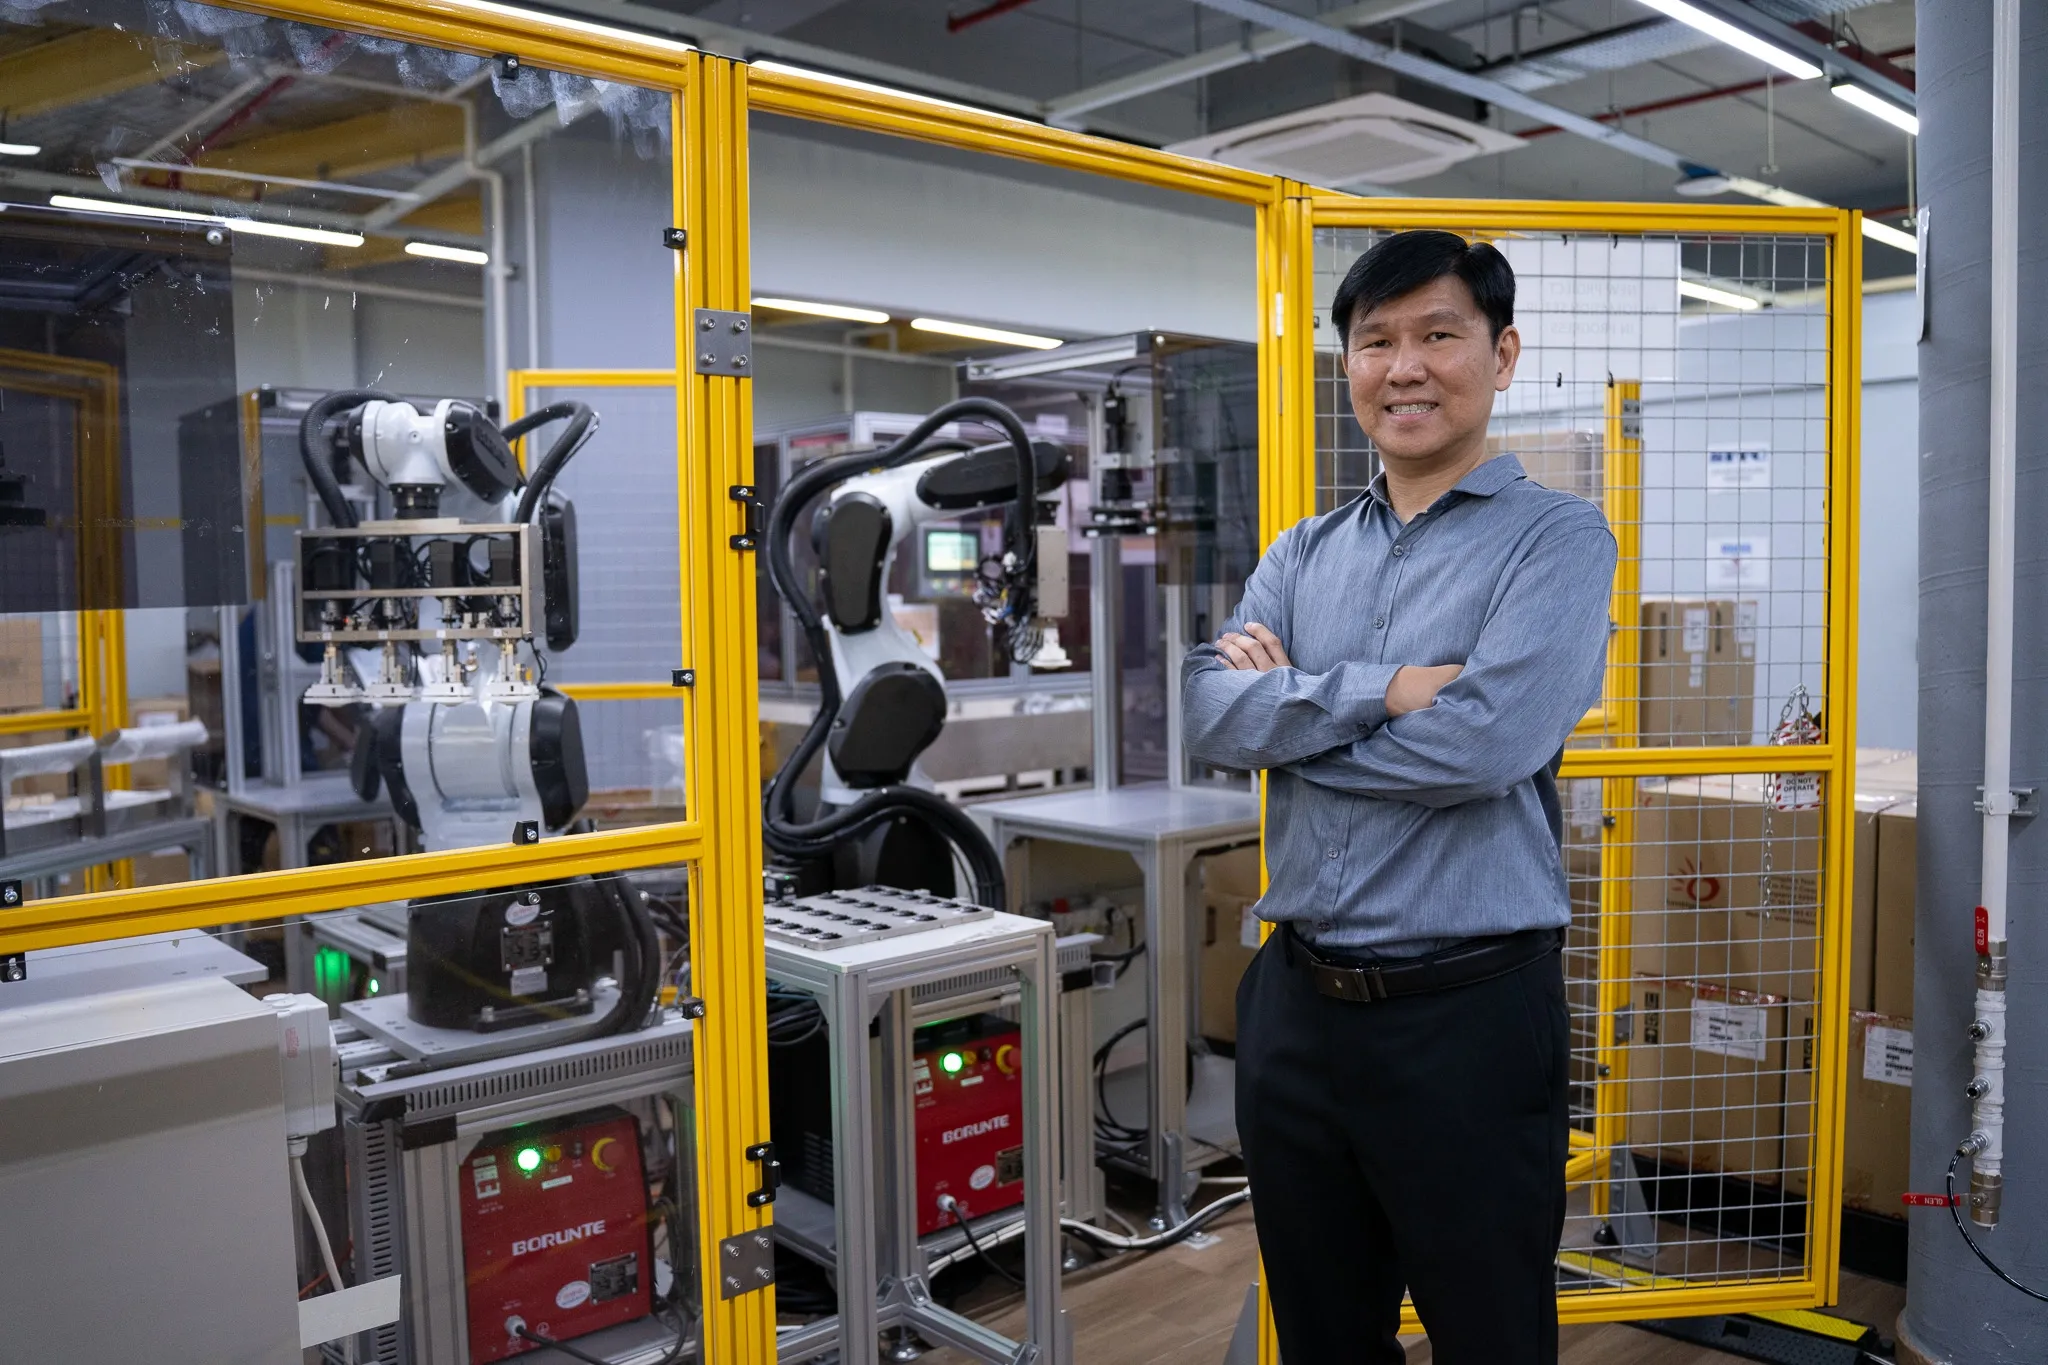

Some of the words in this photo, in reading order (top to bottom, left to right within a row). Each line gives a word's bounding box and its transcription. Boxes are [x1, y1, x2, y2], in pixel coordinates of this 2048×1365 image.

[1783, 784, 1815, 792] OPERATE
[1976, 928, 1985, 946] GLEN
[942, 1114, 1010, 1145] BORUNTE
[1924, 1196, 1944, 1206] GLEN
[512, 1219, 606, 1256] BORUNTE
